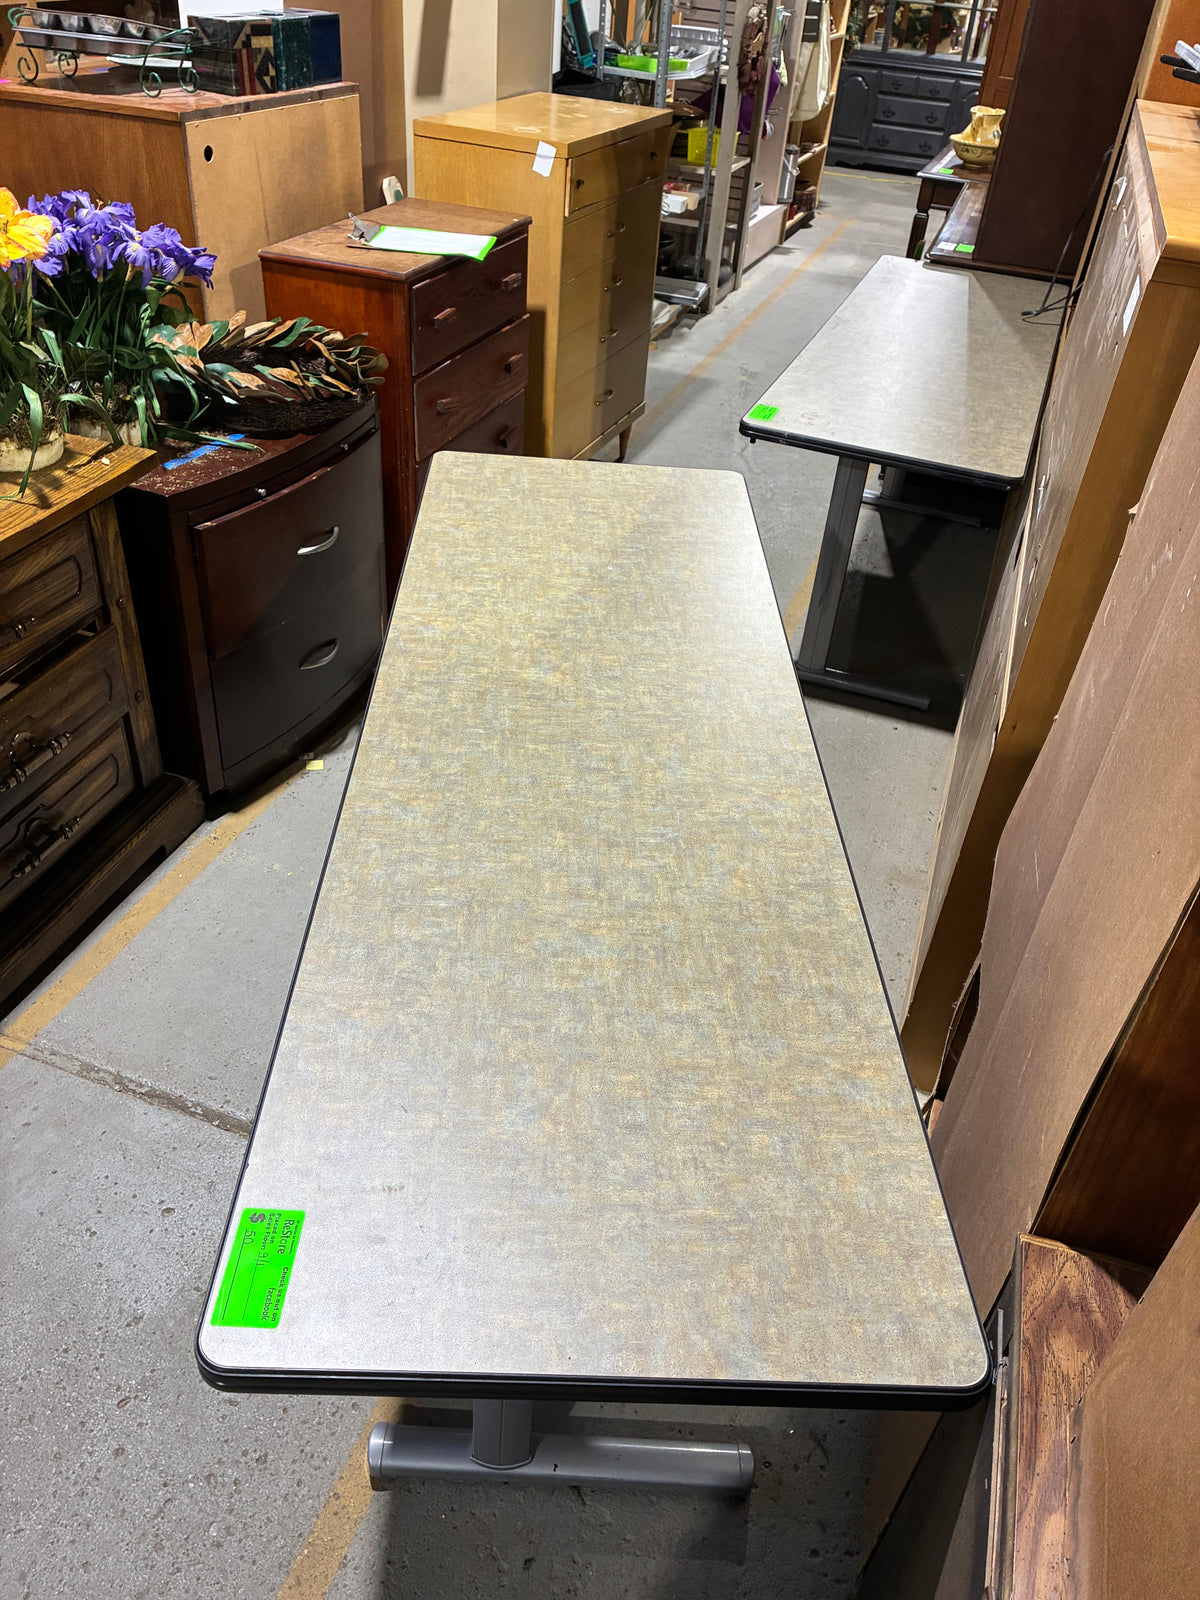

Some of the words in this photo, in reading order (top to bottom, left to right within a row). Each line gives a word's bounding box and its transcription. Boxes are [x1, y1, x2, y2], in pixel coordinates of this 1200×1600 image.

[248, 1212, 266, 1224] $
[271, 1213, 282, 1235] Placed
[277, 1220, 295, 1254] ReStore
[279, 1266, 289, 1288] Check
[261, 1287, 276, 1321] facebook
[273, 1299, 281, 1311] out
[271, 1312, 278, 1322] on
